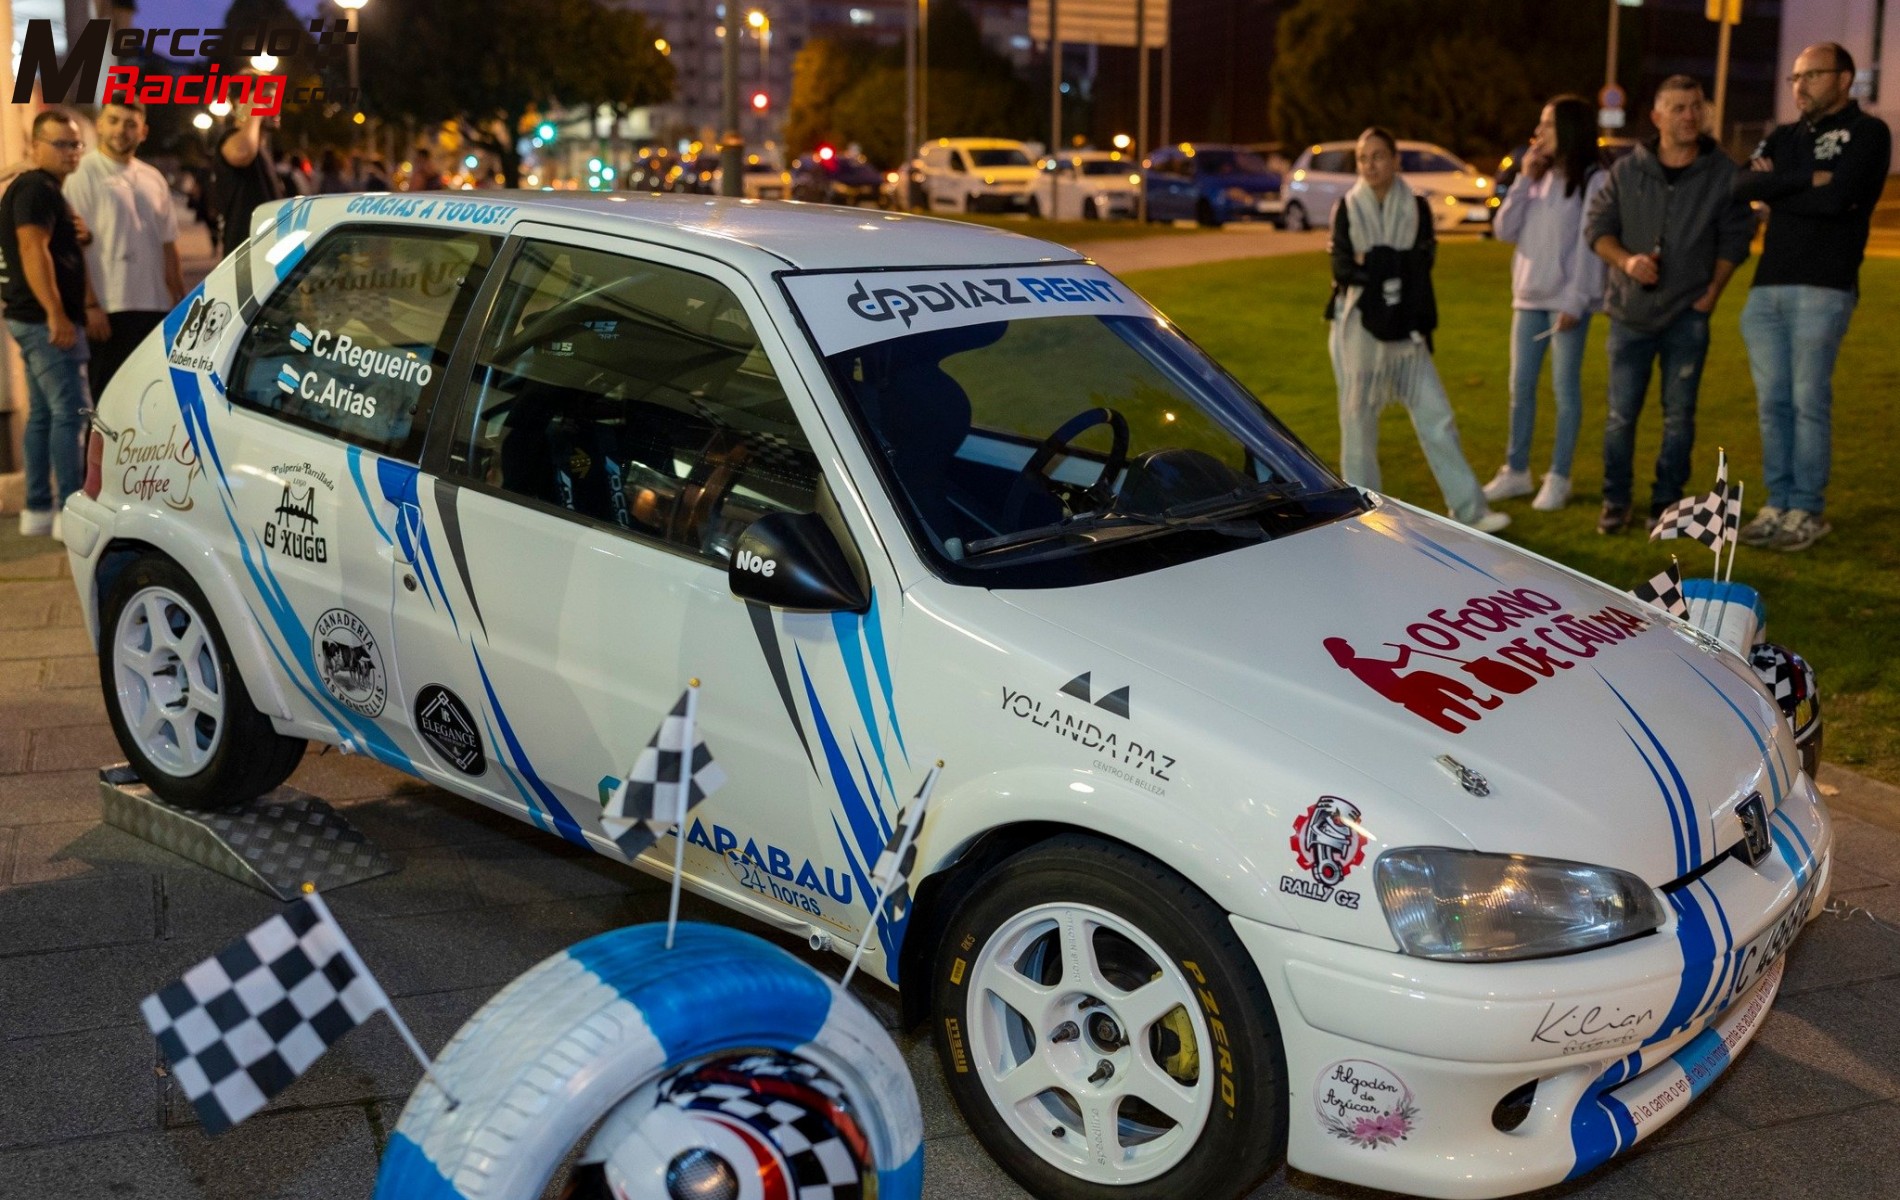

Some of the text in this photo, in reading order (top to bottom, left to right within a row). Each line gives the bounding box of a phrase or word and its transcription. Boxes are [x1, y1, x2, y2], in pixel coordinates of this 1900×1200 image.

[346, 196, 519, 225] GRACIAS A TODOS!!
[169, 349, 214, 372] Rubén e Iria
[312, 329, 433, 386] C.Regueiro
[300, 371, 377, 418] C.Arias
[116, 424, 175, 466] Brunch
[122, 465, 171, 501] Coffee
[264, 521, 328, 563] O XUGO
[736, 550, 776, 577] Noe
[1406, 588, 1562, 651] O FORNO
[1496, 637, 1575, 678] DE
[324, 677, 336, 693] AS
[422, 717, 477, 748] ELEGANCE
[1002, 686, 1177, 782] YOLANDA PAZ
[1092, 759, 1166, 798] CENTRO DE BELLEZA
[734, 861, 822, 916] 24 horas
[1280, 875, 1361, 909] RALLY GZ
[1531, 1001, 1653, 1044] Kilian
[945, 1017, 968, 1073] PIRELLI
[1331, 1064, 1398, 1095] Algodón
[1360, 1091, 1375, 1102] de
[1636, 1103, 1653, 1119] la
[1649, 1091, 1674, 1112] cama
[1669, 1086, 1680, 1097] o
[1675, 1079, 1690, 1093] en
[1322, 1088, 1380, 1118] Azúcar
